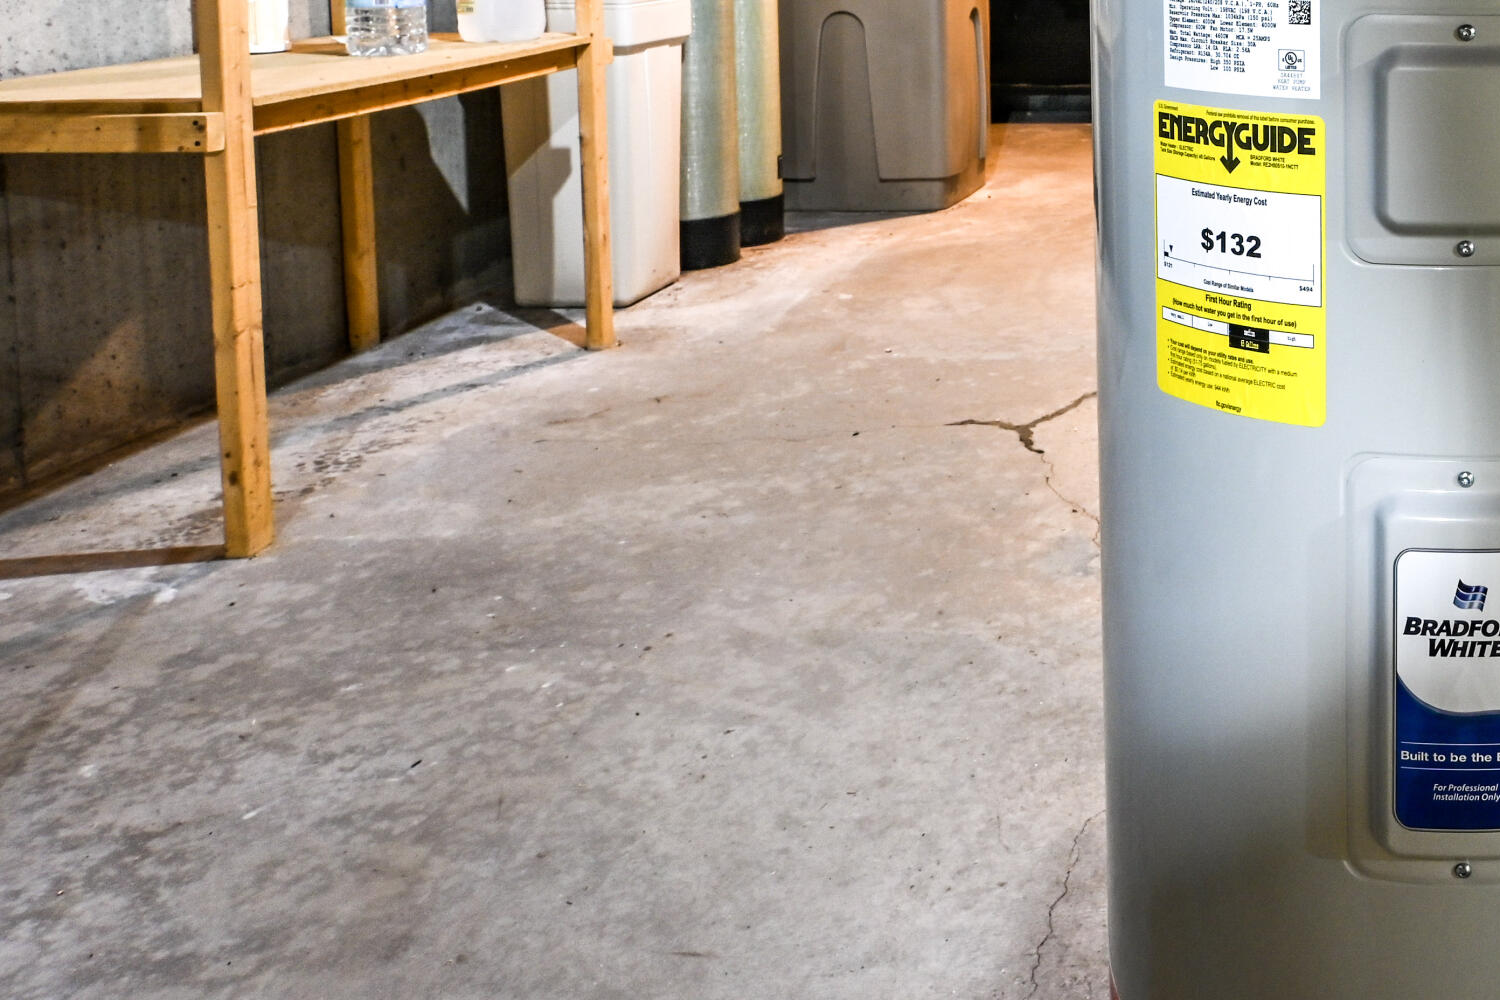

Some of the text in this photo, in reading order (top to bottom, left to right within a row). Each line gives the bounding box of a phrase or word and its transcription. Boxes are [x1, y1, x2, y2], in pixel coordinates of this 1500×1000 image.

[1158, 111, 1316, 155] ENERGYGUIDE
[1250, 154, 1272, 162] BRADFORD
[1191, 188, 1267, 206] Estimated Yearly Energy Cost
[1200, 228, 1262, 259] $132
[1206, 294, 1252, 311] First Hour Rating
[1173, 297, 1183, 306] (How
[1183, 301, 1195, 310] much
[1203, 305, 1216, 315] water
[1217, 309, 1226, 317] you
[1227, 310, 1236, 319] get
[1236, 311, 1241, 319] in
[1242, 312, 1250, 320] the
[1251, 314, 1263, 323] first
[1284, 320, 1297, 329] use)
[1400, 750, 1430, 762] Built
[1433, 751, 1446, 762] to
[1450, 751, 1467, 763] be
[1471, 752, 1492, 763] the
[1433, 783, 1499, 793] For Professional
[1433, 792, 1500, 803] Installation Only
